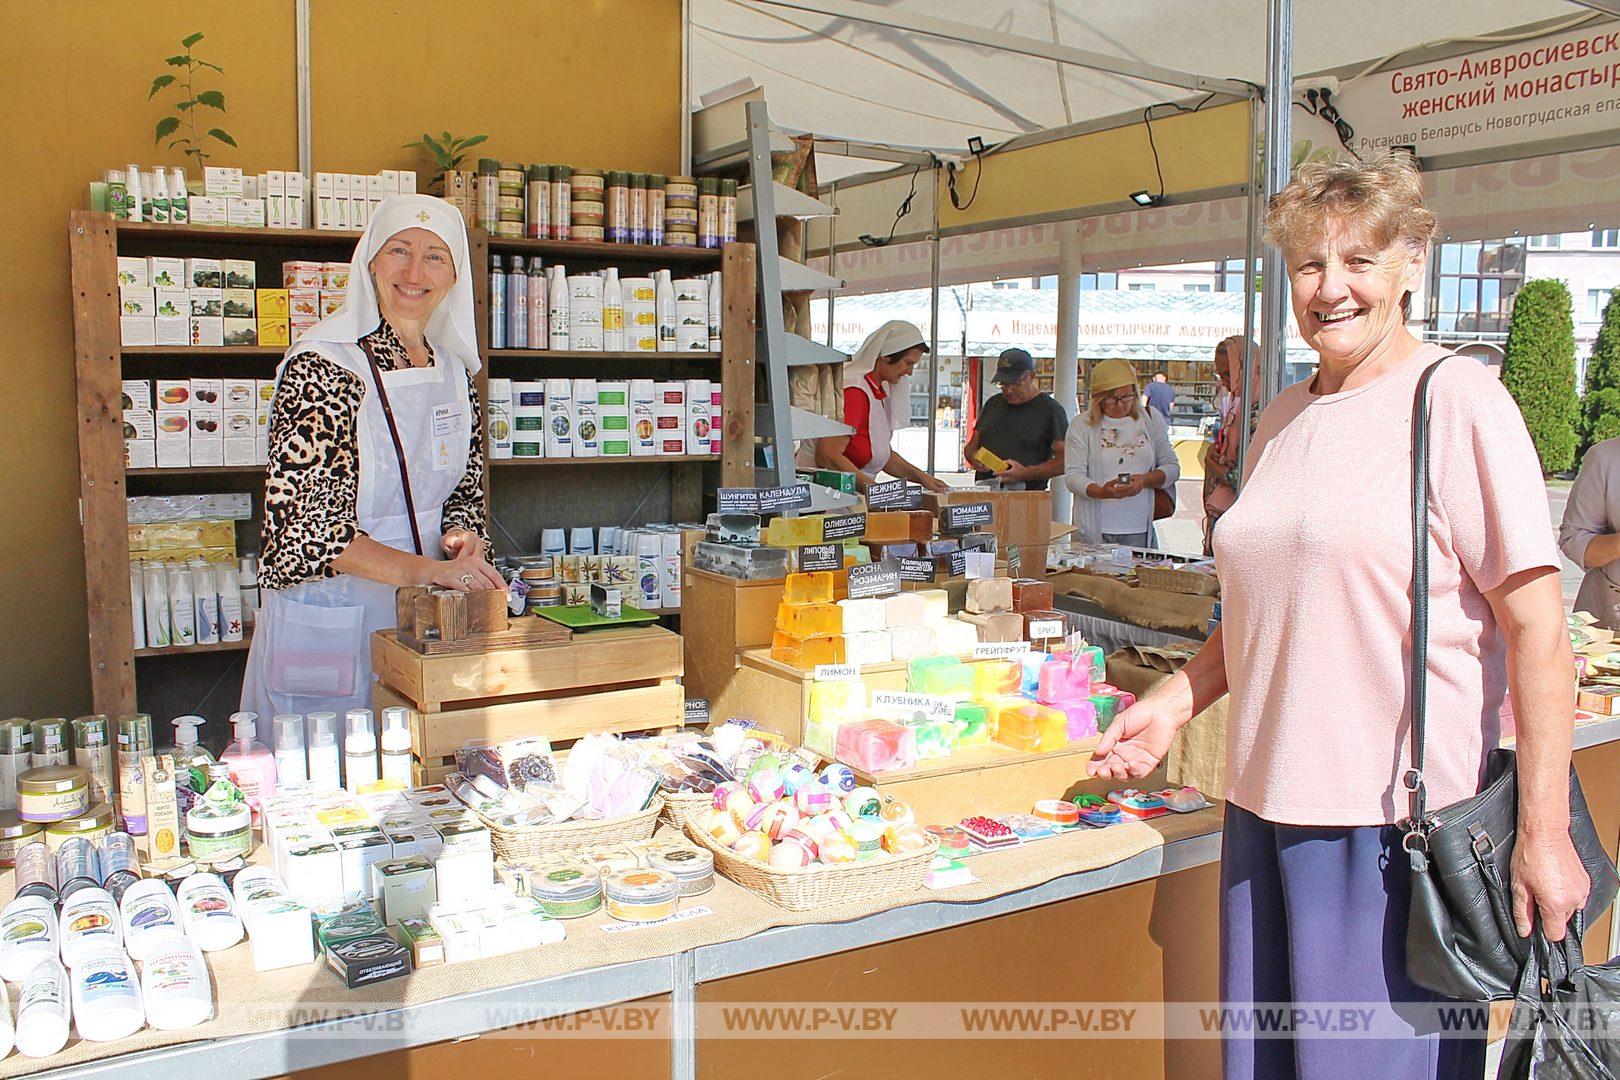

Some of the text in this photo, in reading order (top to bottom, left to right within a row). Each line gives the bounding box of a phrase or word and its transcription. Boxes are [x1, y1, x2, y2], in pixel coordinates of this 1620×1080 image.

[1402, 80, 1496, 119] женский
[1361, 132, 1417, 151] Русаково
[1421, 122, 1482, 140] Беларусь
[1486, 103, 1590, 131] Новогрудская
[759, 485, 807, 501] КАЛЕНДУЛА
[868, 481, 903, 495] НЕЖНОЕ
[951, 504, 988, 515] РОМАШКА
[824, 517, 866, 530] ОЛИВКОВОЕ
[803, 545, 836, 556] ЛИПОВЫЙ
[818, 552, 836, 561] ЦВЕТ
[852, 565, 882, 576] СОСНА
[853, 571, 898, 587] РОЗМАРИН
[975, 644, 1028, 656] ГРЕЙПФРУТ
[819, 668, 856, 677] ЛИМОН
[875, 695, 931, 708] КЛУБНИКА
[358, 959, 403, 975] ОТБЕЛИВАЮЩИЙ
